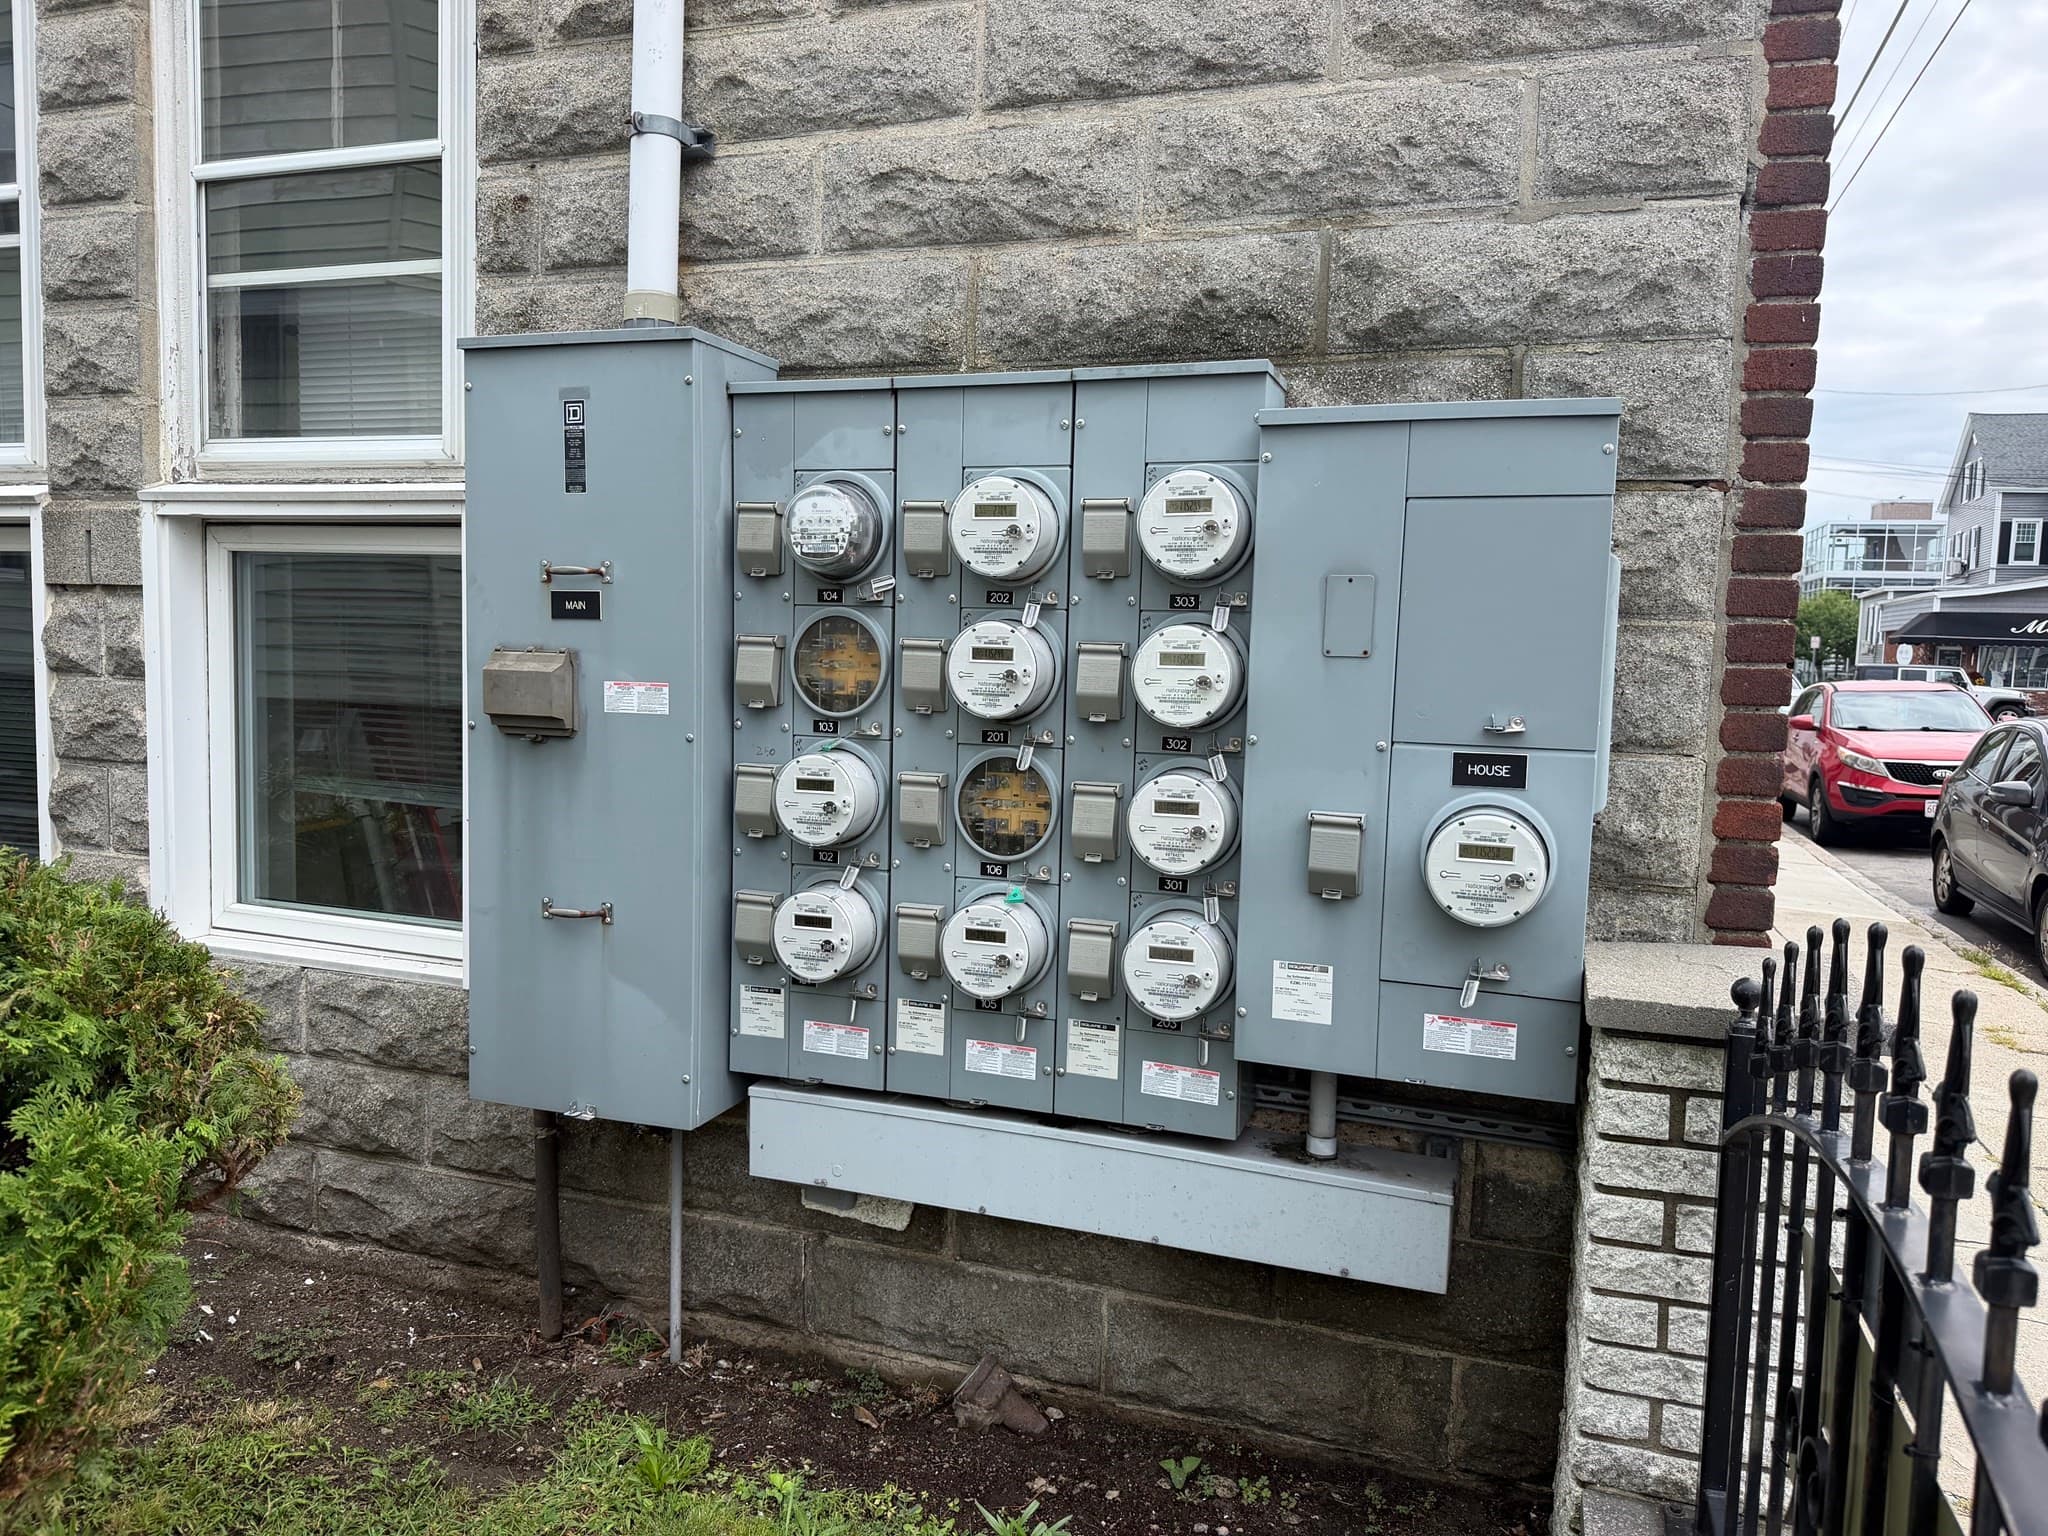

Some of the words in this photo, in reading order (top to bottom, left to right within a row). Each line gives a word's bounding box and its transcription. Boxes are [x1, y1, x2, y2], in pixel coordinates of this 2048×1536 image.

[823, 591, 838, 601] 104
[990, 592, 1009, 604] 202
[565, 600, 586, 610] MAIN
[1174, 596, 1195, 608] 303
[2010, 619, 2048, 634] M
[818, 722, 834, 733] 103
[987, 732, 1004, 743] 201
[1166, 738, 1187, 751] 302
[1467, 762, 1511, 777] HOUSE
[818, 851, 834, 862] 102
[986, 864, 1003, 876] 106
[1164, 879, 1183, 891] 301
[1465, 882, 1503, 891] nationalgrid
[981, 999, 997, 1009] 105
